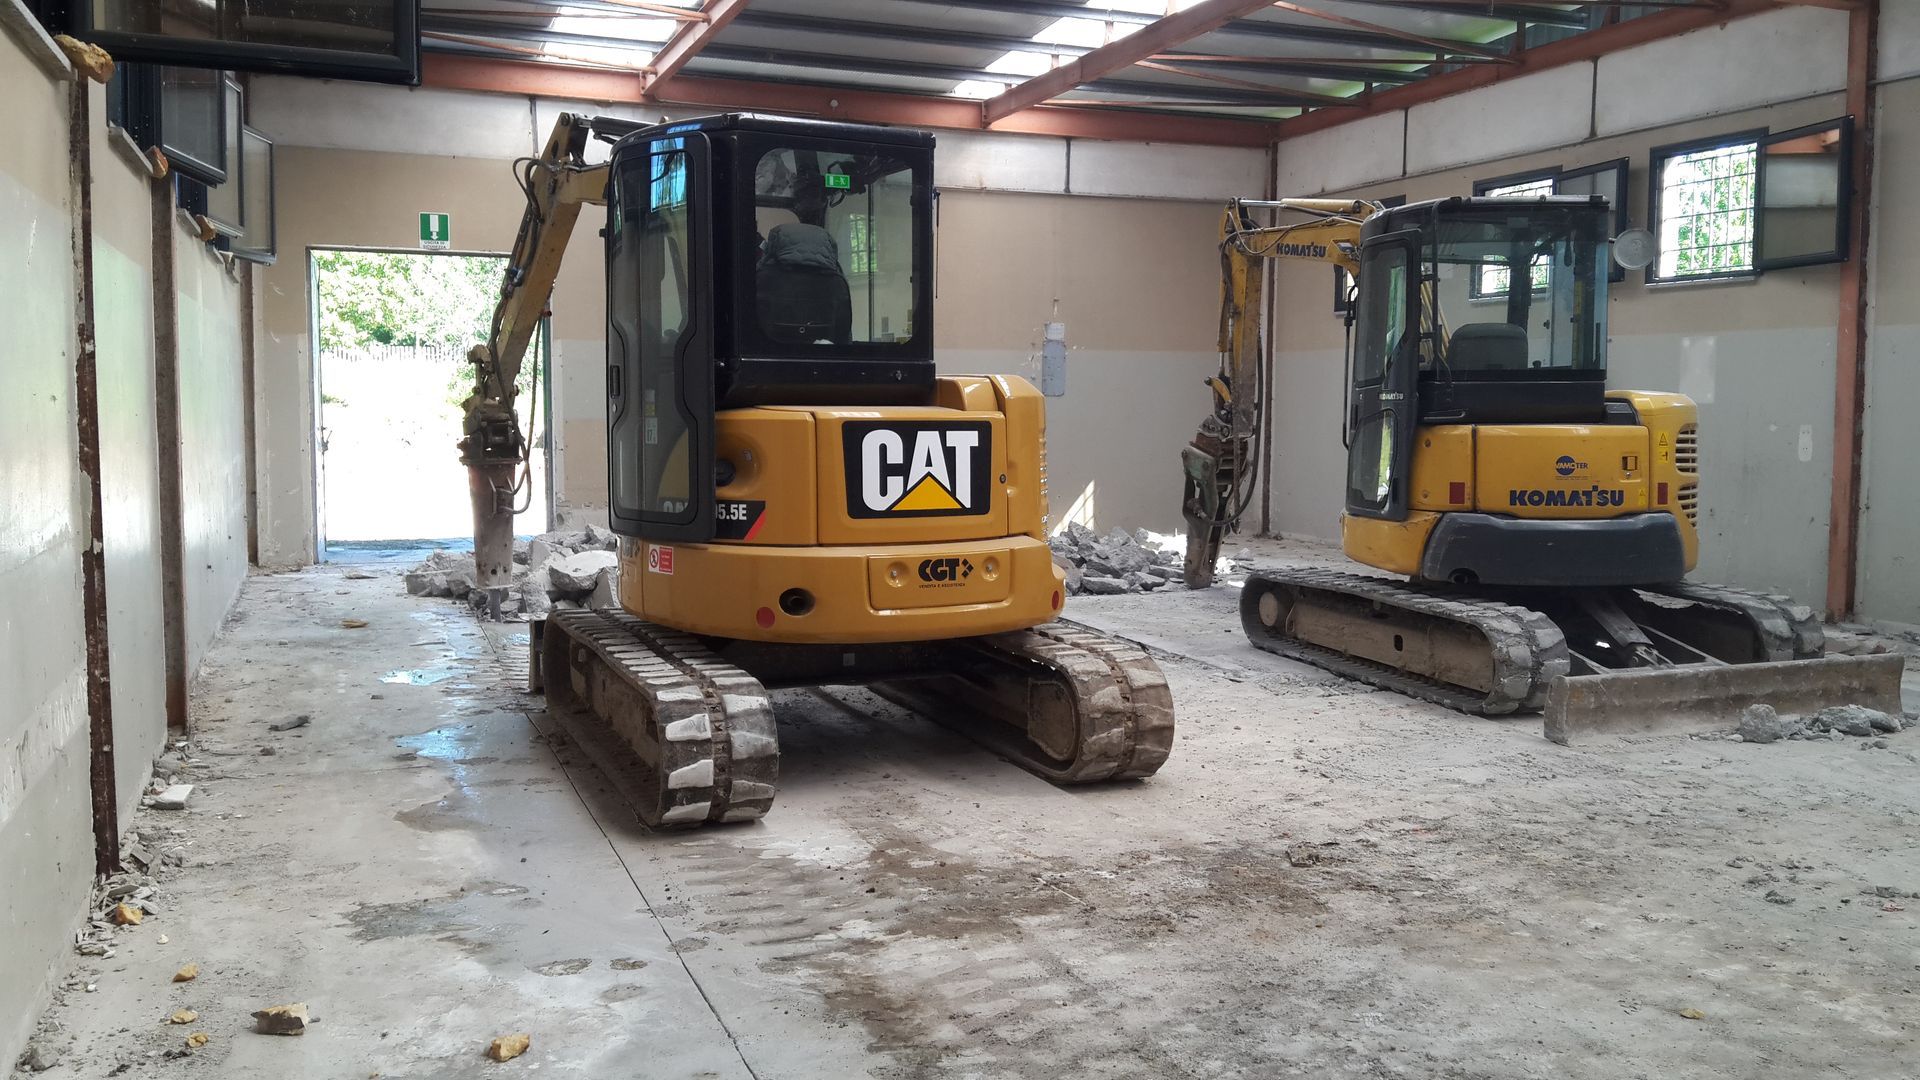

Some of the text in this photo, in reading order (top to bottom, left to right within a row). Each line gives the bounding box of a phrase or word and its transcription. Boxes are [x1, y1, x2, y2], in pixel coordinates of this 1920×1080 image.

[1276, 241, 1326, 258] KOMATSU
[862, 429, 978, 511] CAT
[1510, 485, 1624, 507] KOMATSU
[716, 504, 747, 520] 5.5E
[918, 558, 960, 582] CGT
